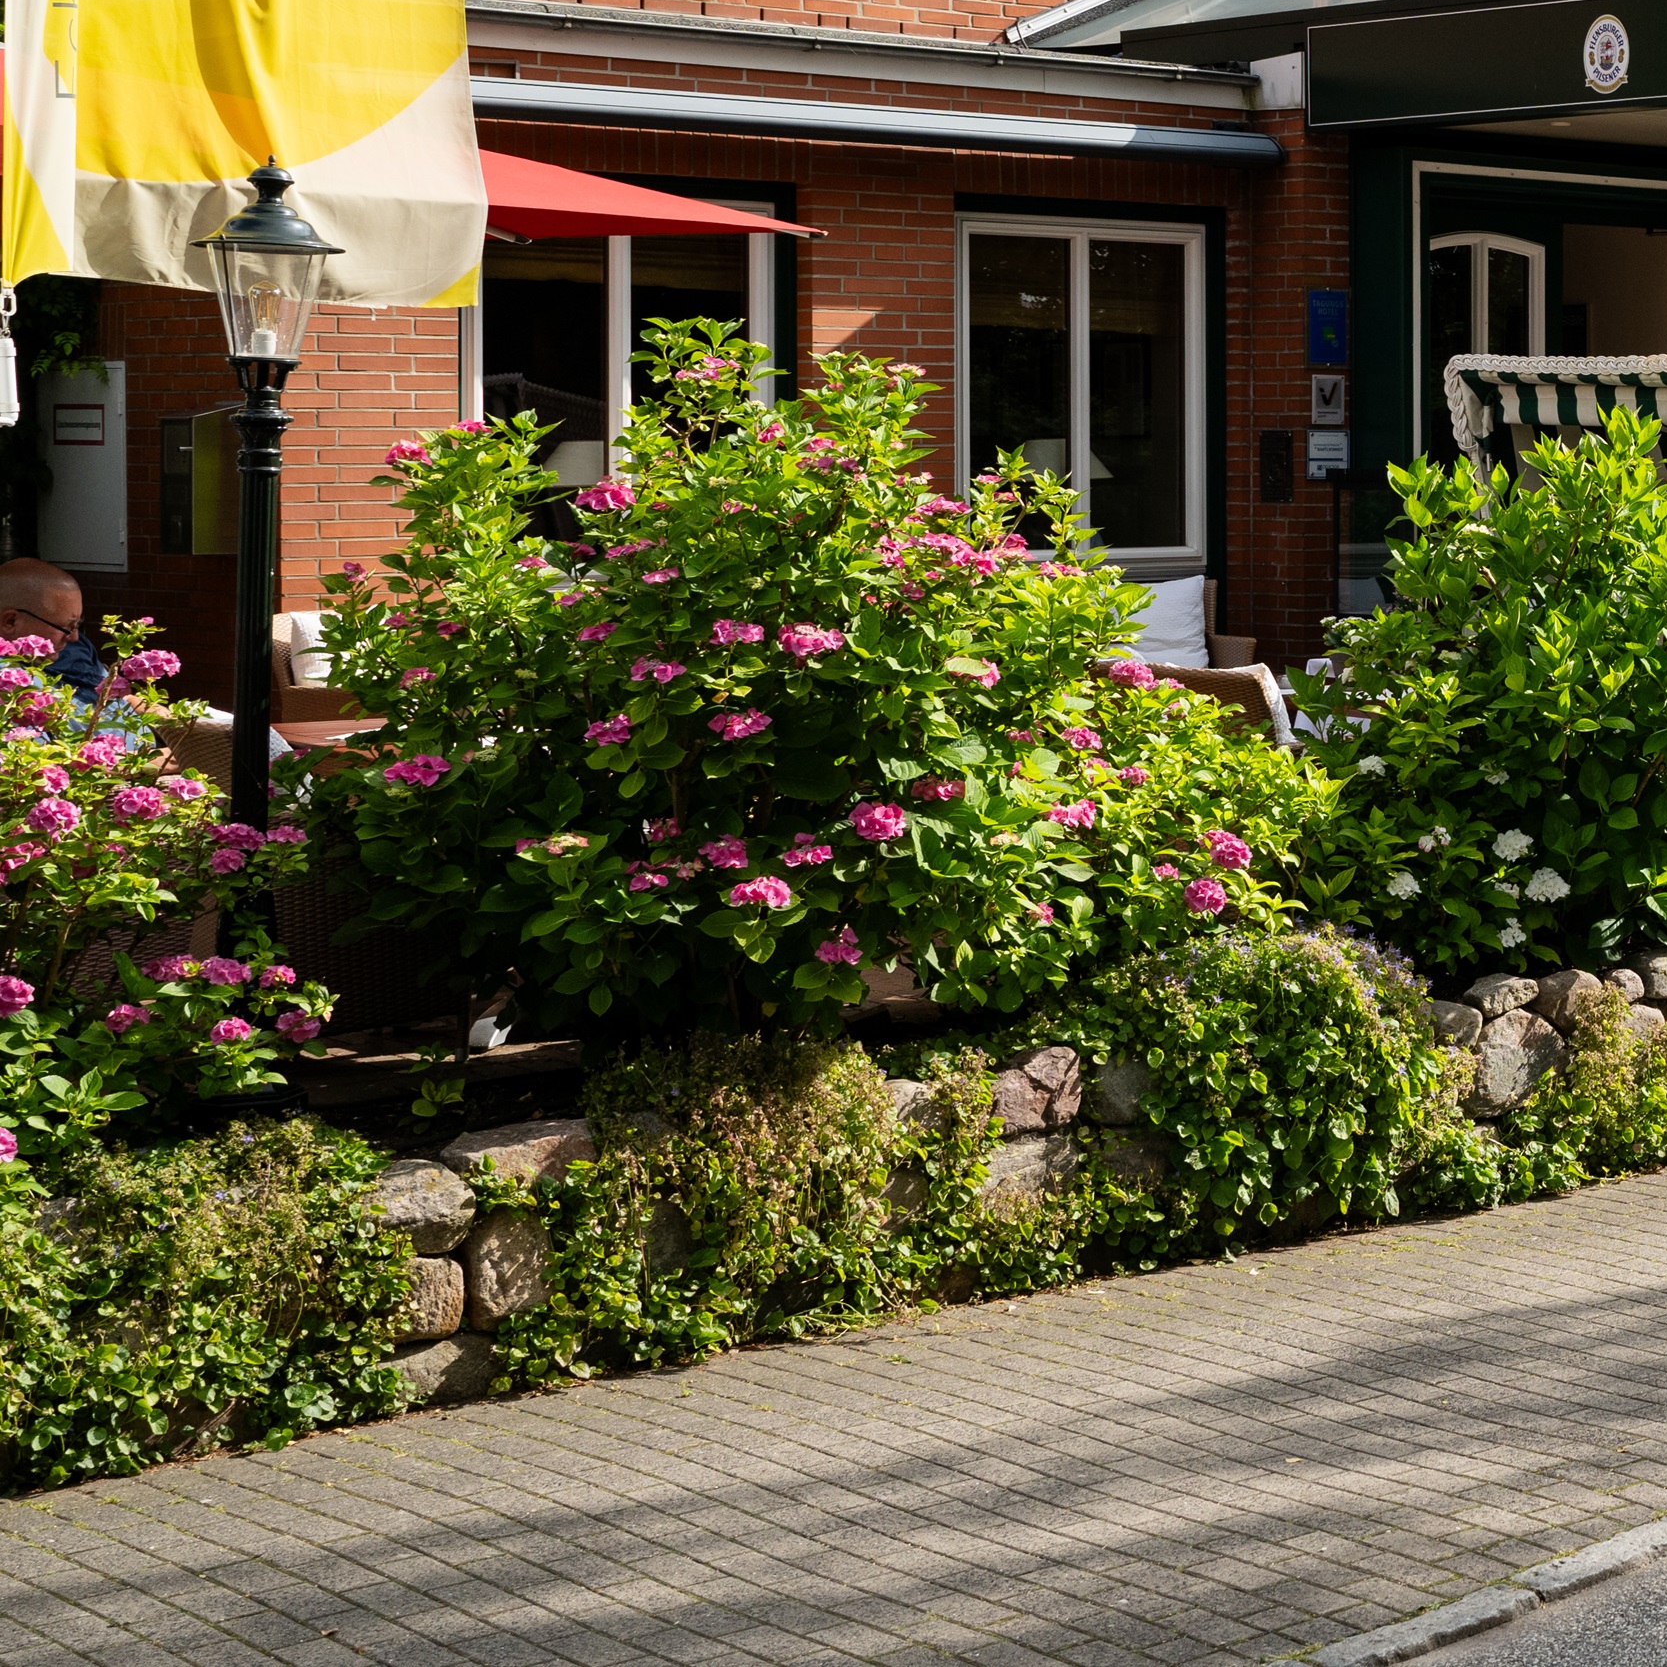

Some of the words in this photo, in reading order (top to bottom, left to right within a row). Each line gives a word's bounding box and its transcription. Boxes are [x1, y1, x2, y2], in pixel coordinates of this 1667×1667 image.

[1588, 23, 1625, 50] FLENSBURGER
[1592, 65, 1622, 83] PILSENER
[1317, 308, 1339, 316] HOTEL
